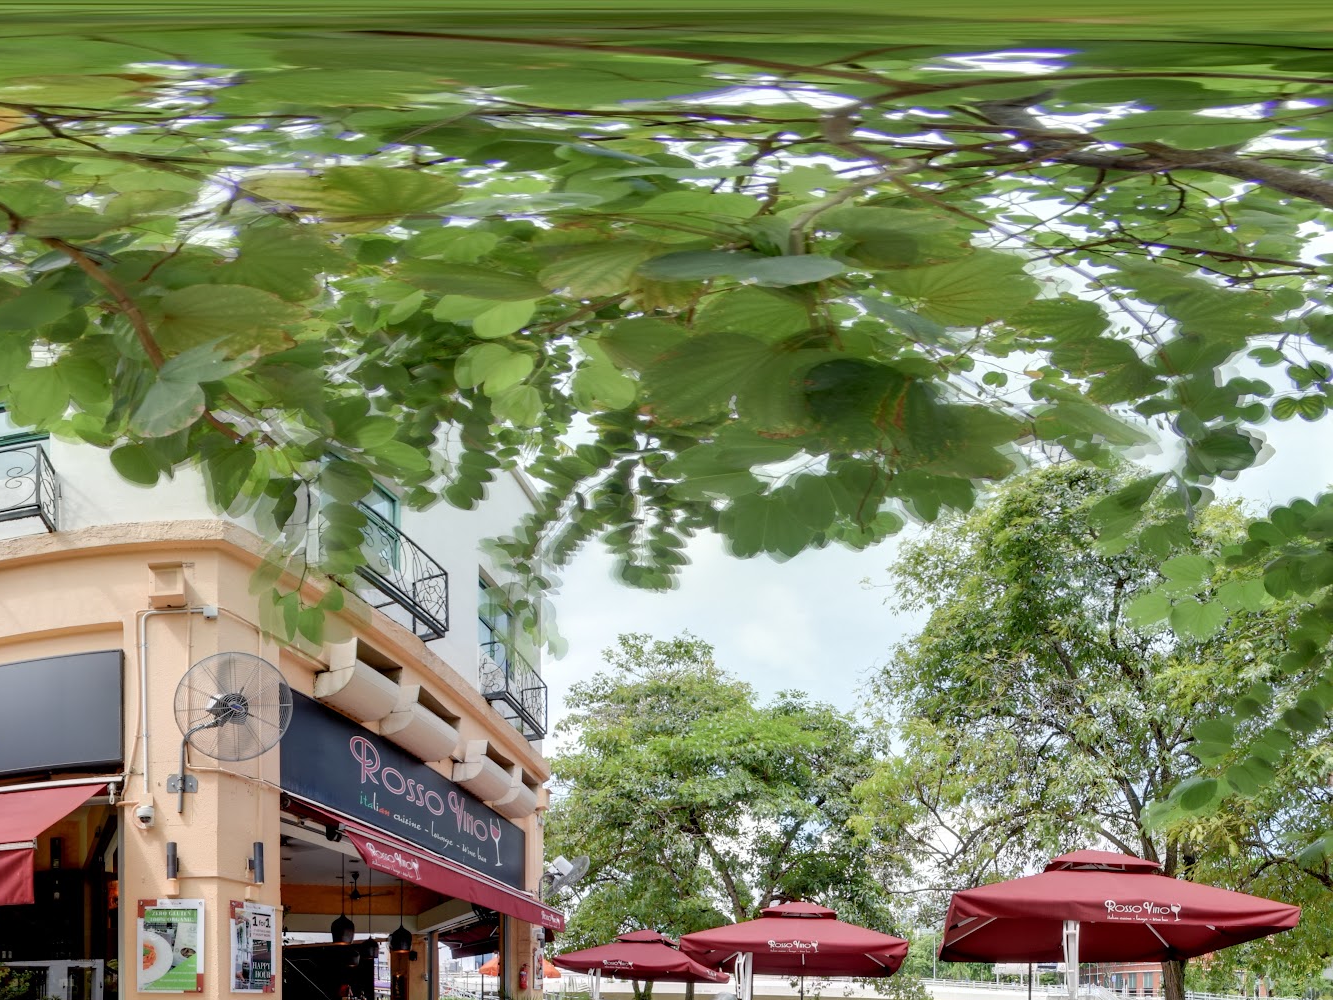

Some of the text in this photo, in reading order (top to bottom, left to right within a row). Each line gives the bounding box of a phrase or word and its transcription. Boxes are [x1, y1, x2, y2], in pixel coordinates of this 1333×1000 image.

[359, 791, 390, 817] italian
[393, 813, 422, 831] cuisine
[431, 820, 454, 850] lounge
[477, 847, 487, 863] bar
[252, 916, 258, 926] 1
[265, 918, 271, 928] 1
[253, 962, 271, 970] HAPPY
